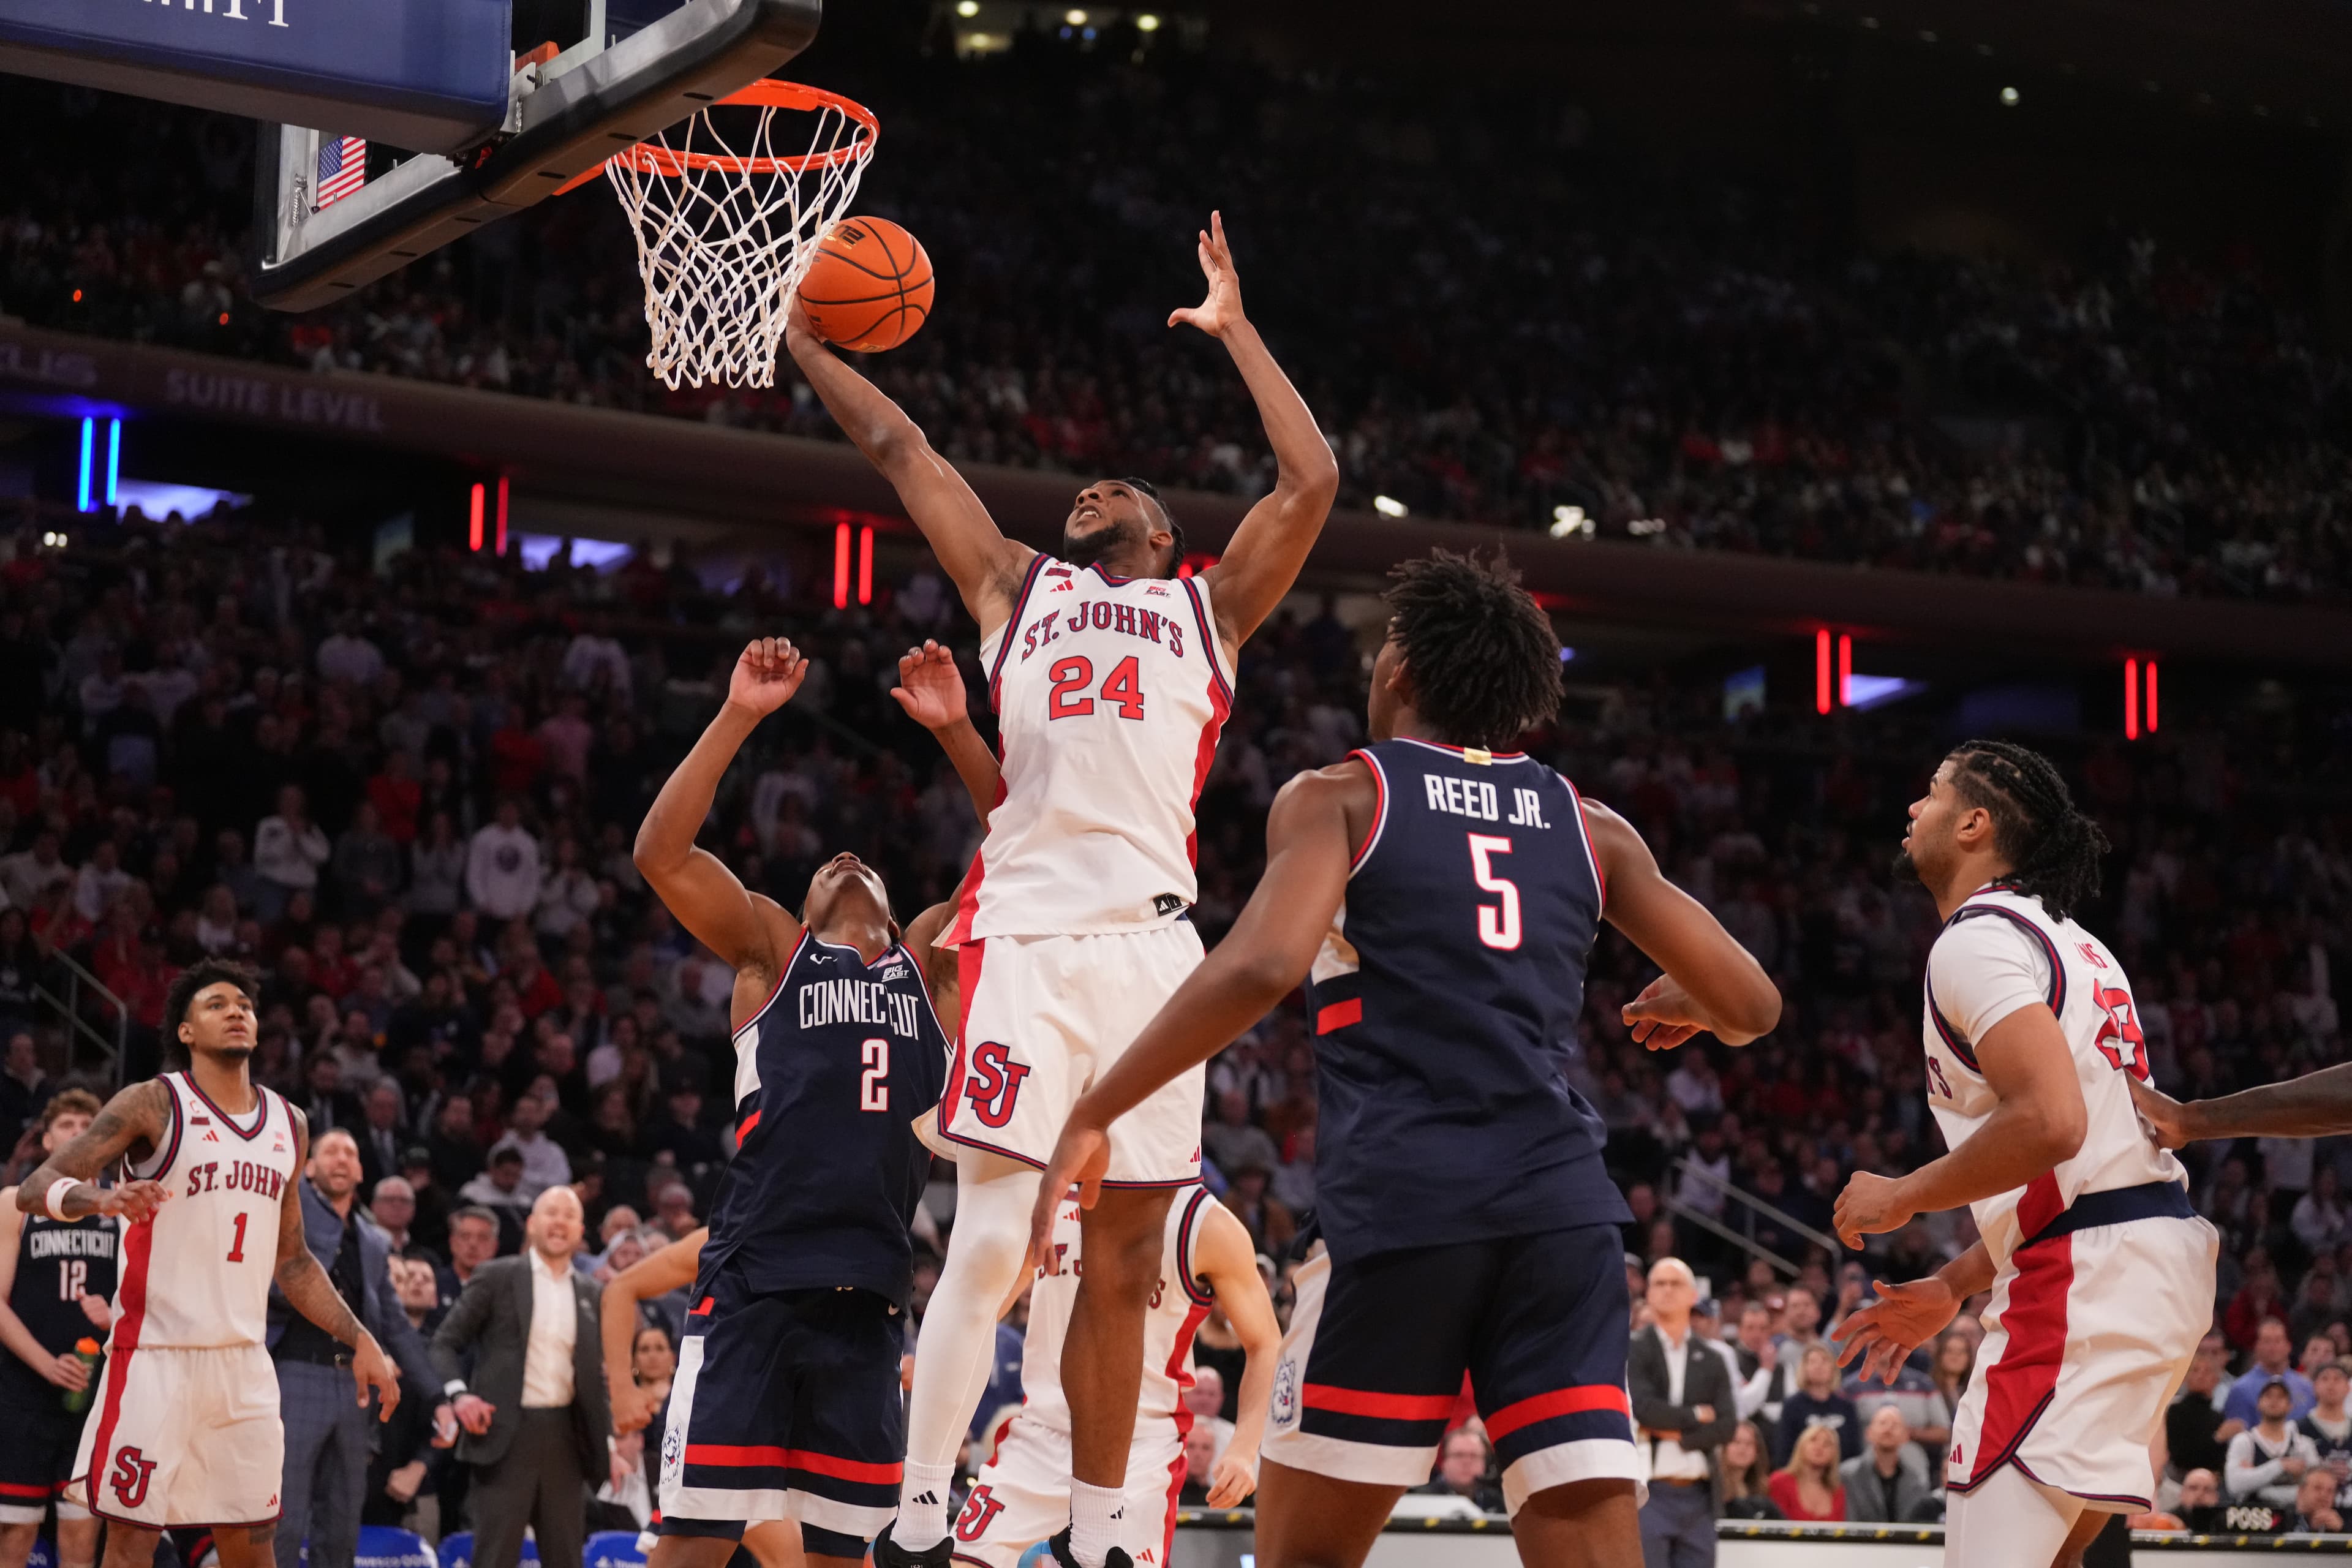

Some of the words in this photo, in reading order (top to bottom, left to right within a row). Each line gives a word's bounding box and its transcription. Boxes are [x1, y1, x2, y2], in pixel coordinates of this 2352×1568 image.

[165, 369, 270, 417] SUITE
[279, 383, 385, 434] LEVEL
[1021, 609, 1060, 664] ST.
[1068, 601, 1183, 657] JOHN'S
[1049, 655, 1144, 721] 24
[1423, 774, 1499, 821] REED
[1508, 788, 1551, 829] JR.
[1467, 831, 1523, 951] 5
[882, 970, 909, 981] EAST
[884, 964, 903, 974] BIG
[860, 1038, 889, 1112] 2
[186, 1161, 219, 1199] ST.
[30, 1229, 115, 1259] CONNECTICUT
[227, 1212, 247, 1263] 1
[59, 1259, 87, 1302] 12
[2226, 1506, 2273, 1530] POSS
